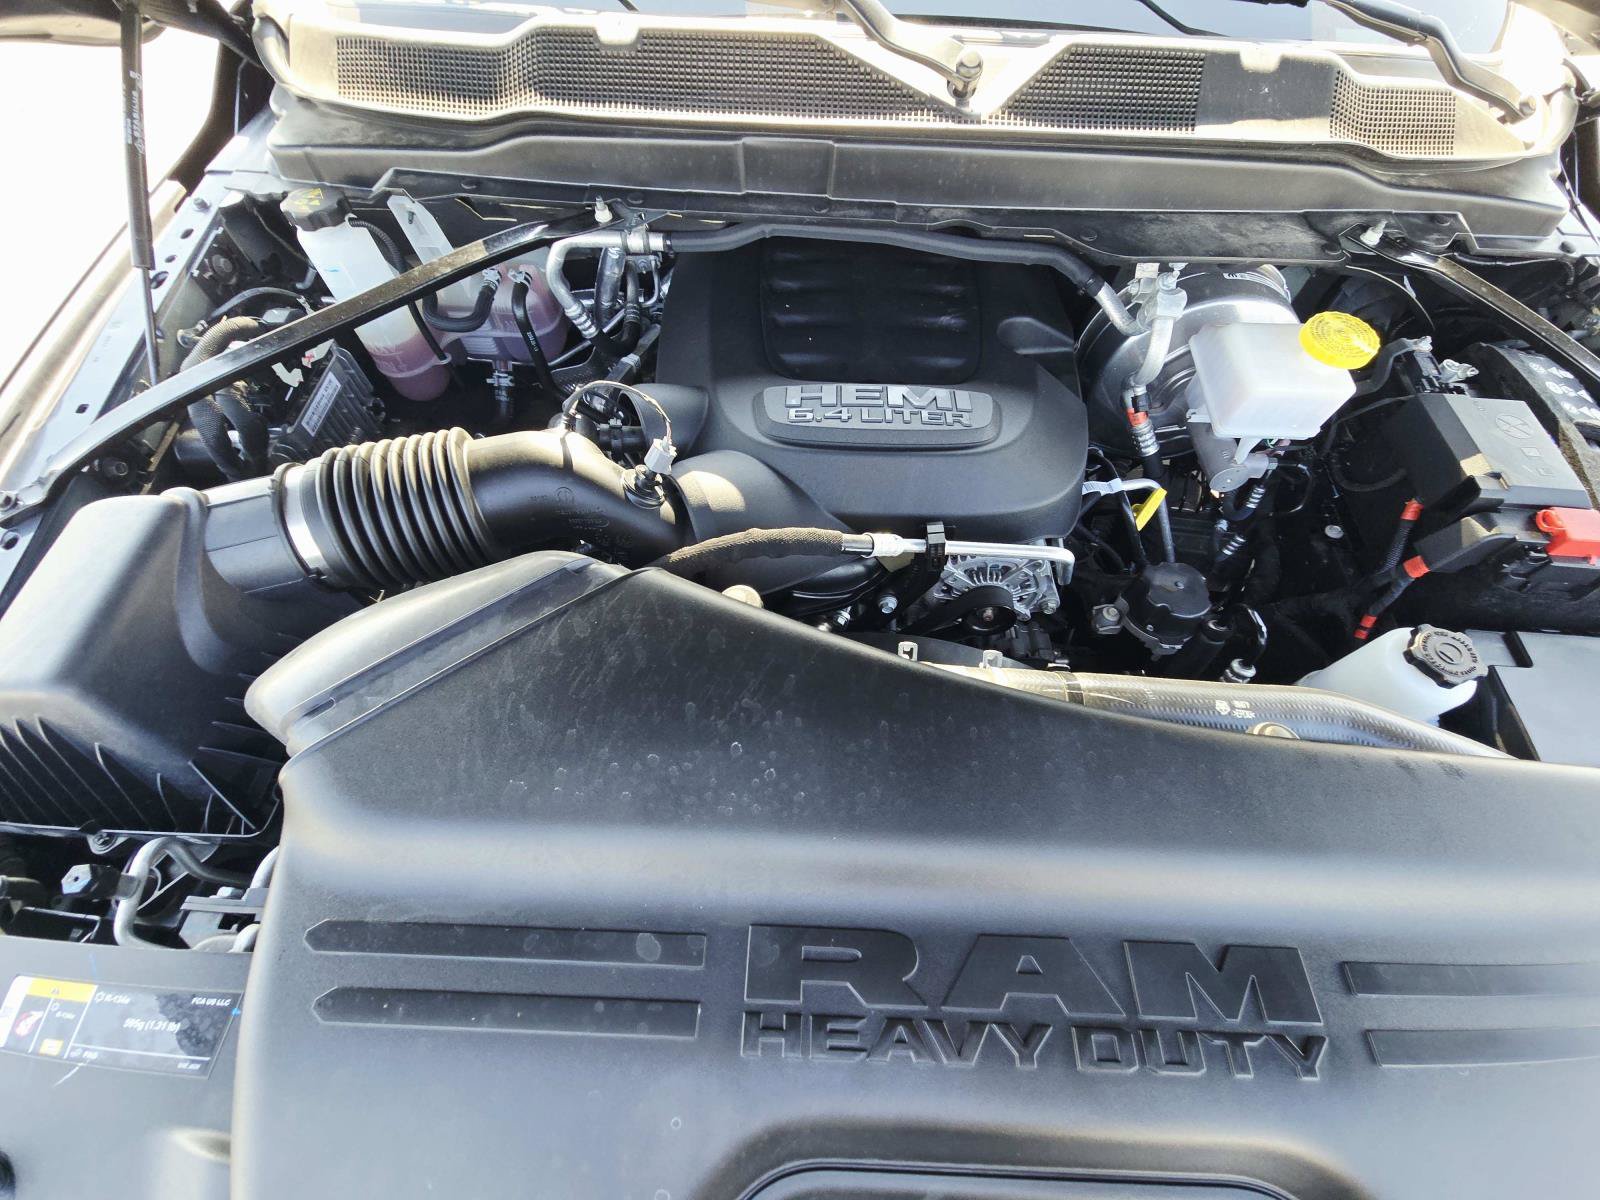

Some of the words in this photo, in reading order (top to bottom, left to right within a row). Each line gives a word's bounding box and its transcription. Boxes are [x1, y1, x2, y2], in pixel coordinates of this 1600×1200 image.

[785, 384, 973, 412] HEMI
[787, 408, 852, 423] 6.4
[861, 408, 972, 427] LITER
[743, 923, 1323, 1026] RAM
[740, 1010, 1053, 1069] HEAVY
[1071, 1025, 1329, 1081] DUTY
